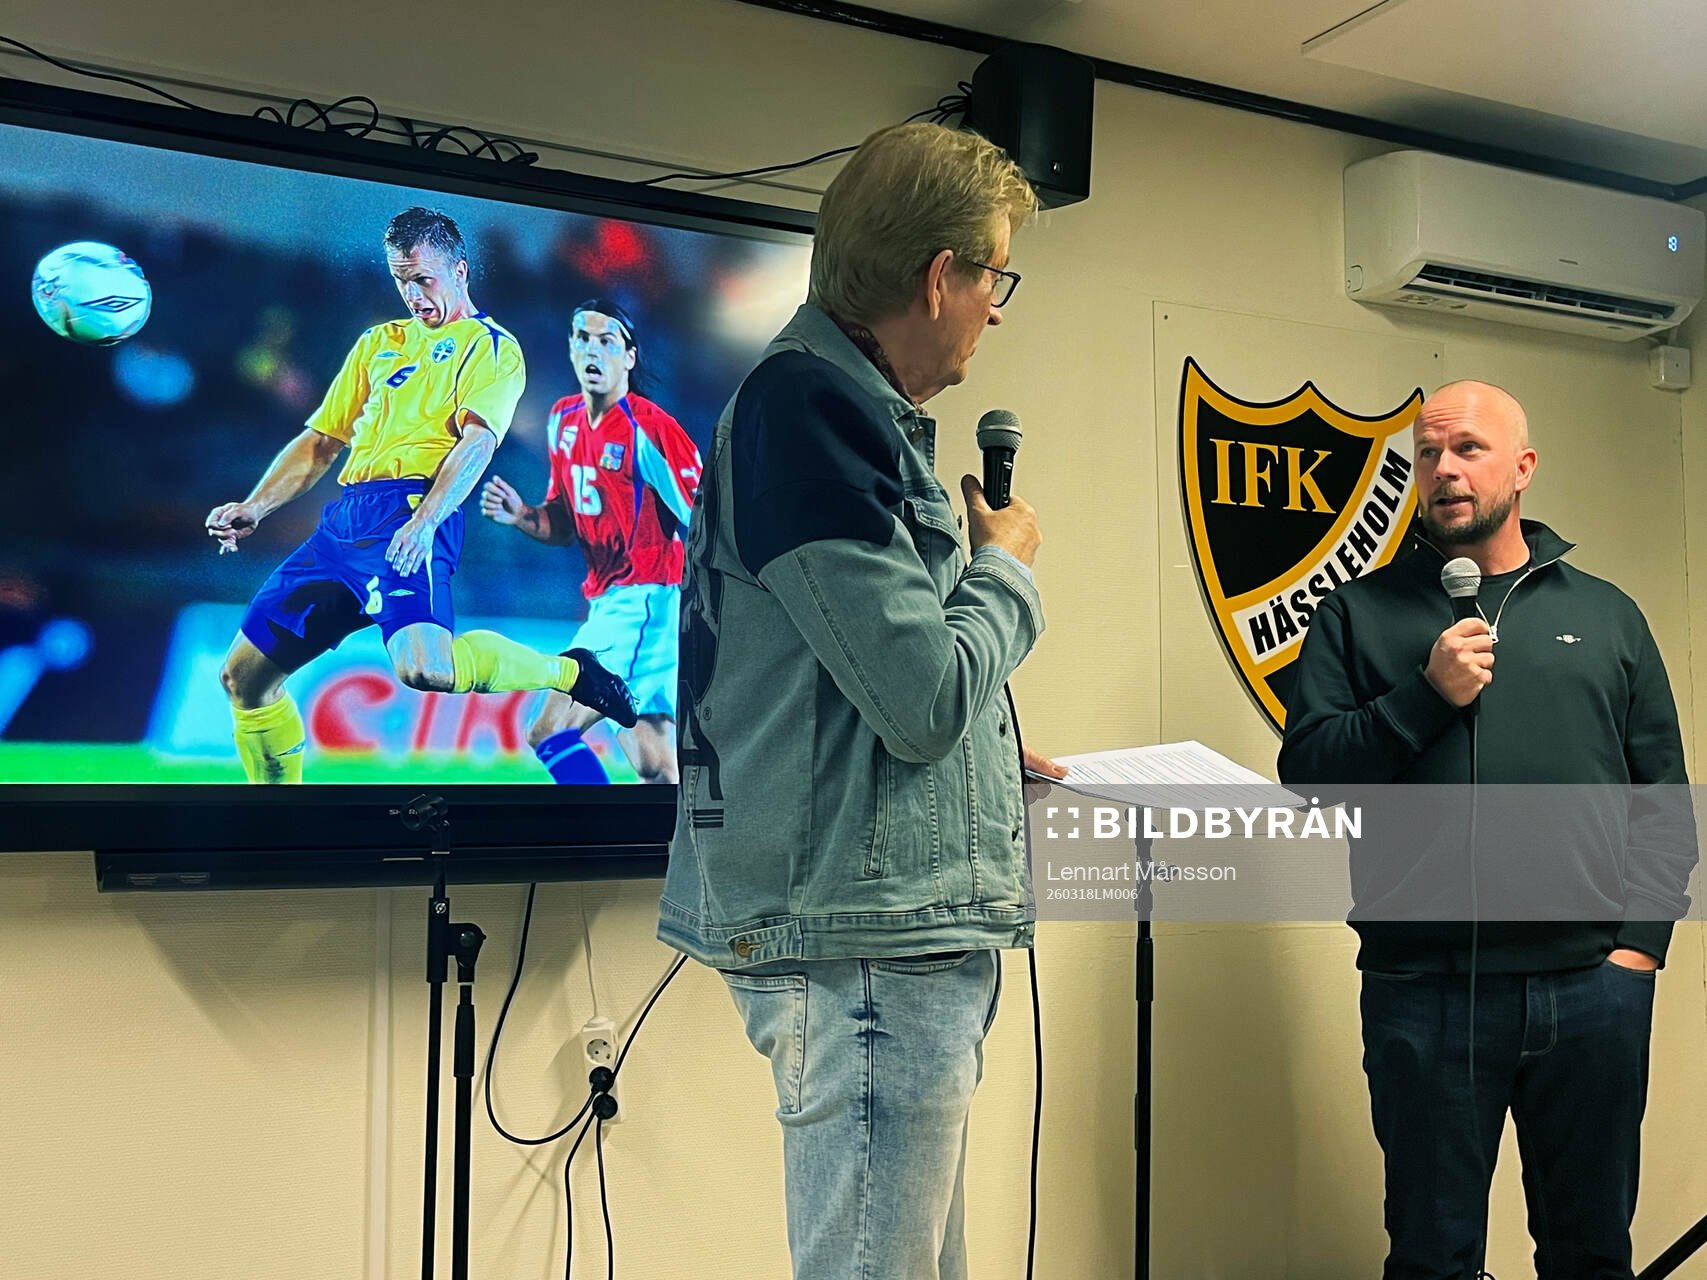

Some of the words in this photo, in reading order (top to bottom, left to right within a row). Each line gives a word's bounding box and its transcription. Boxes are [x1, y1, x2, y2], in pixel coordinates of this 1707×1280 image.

[385, 365, 417, 389] 6
[571, 464, 602, 515] 15
[1209, 438, 1336, 514] IFK
